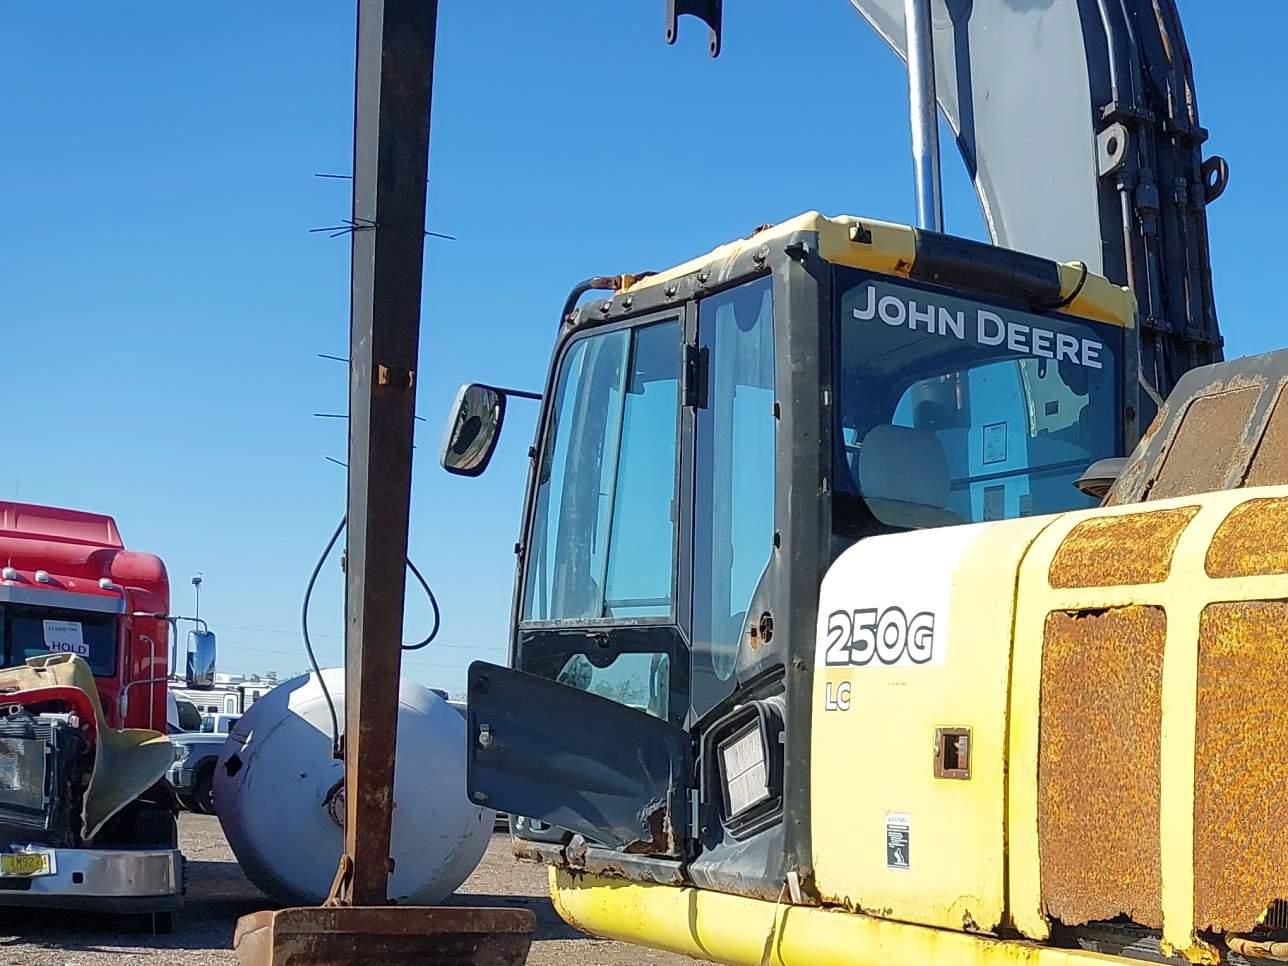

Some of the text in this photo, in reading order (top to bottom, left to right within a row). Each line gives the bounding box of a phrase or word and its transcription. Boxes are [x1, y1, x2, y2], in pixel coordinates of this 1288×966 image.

[853, 285, 1104, 370] JOHN DEERE
[52, 641, 87, 654] HOLD
[824, 605, 935, 666] 250G
[824, 681, 852, 712] LC
